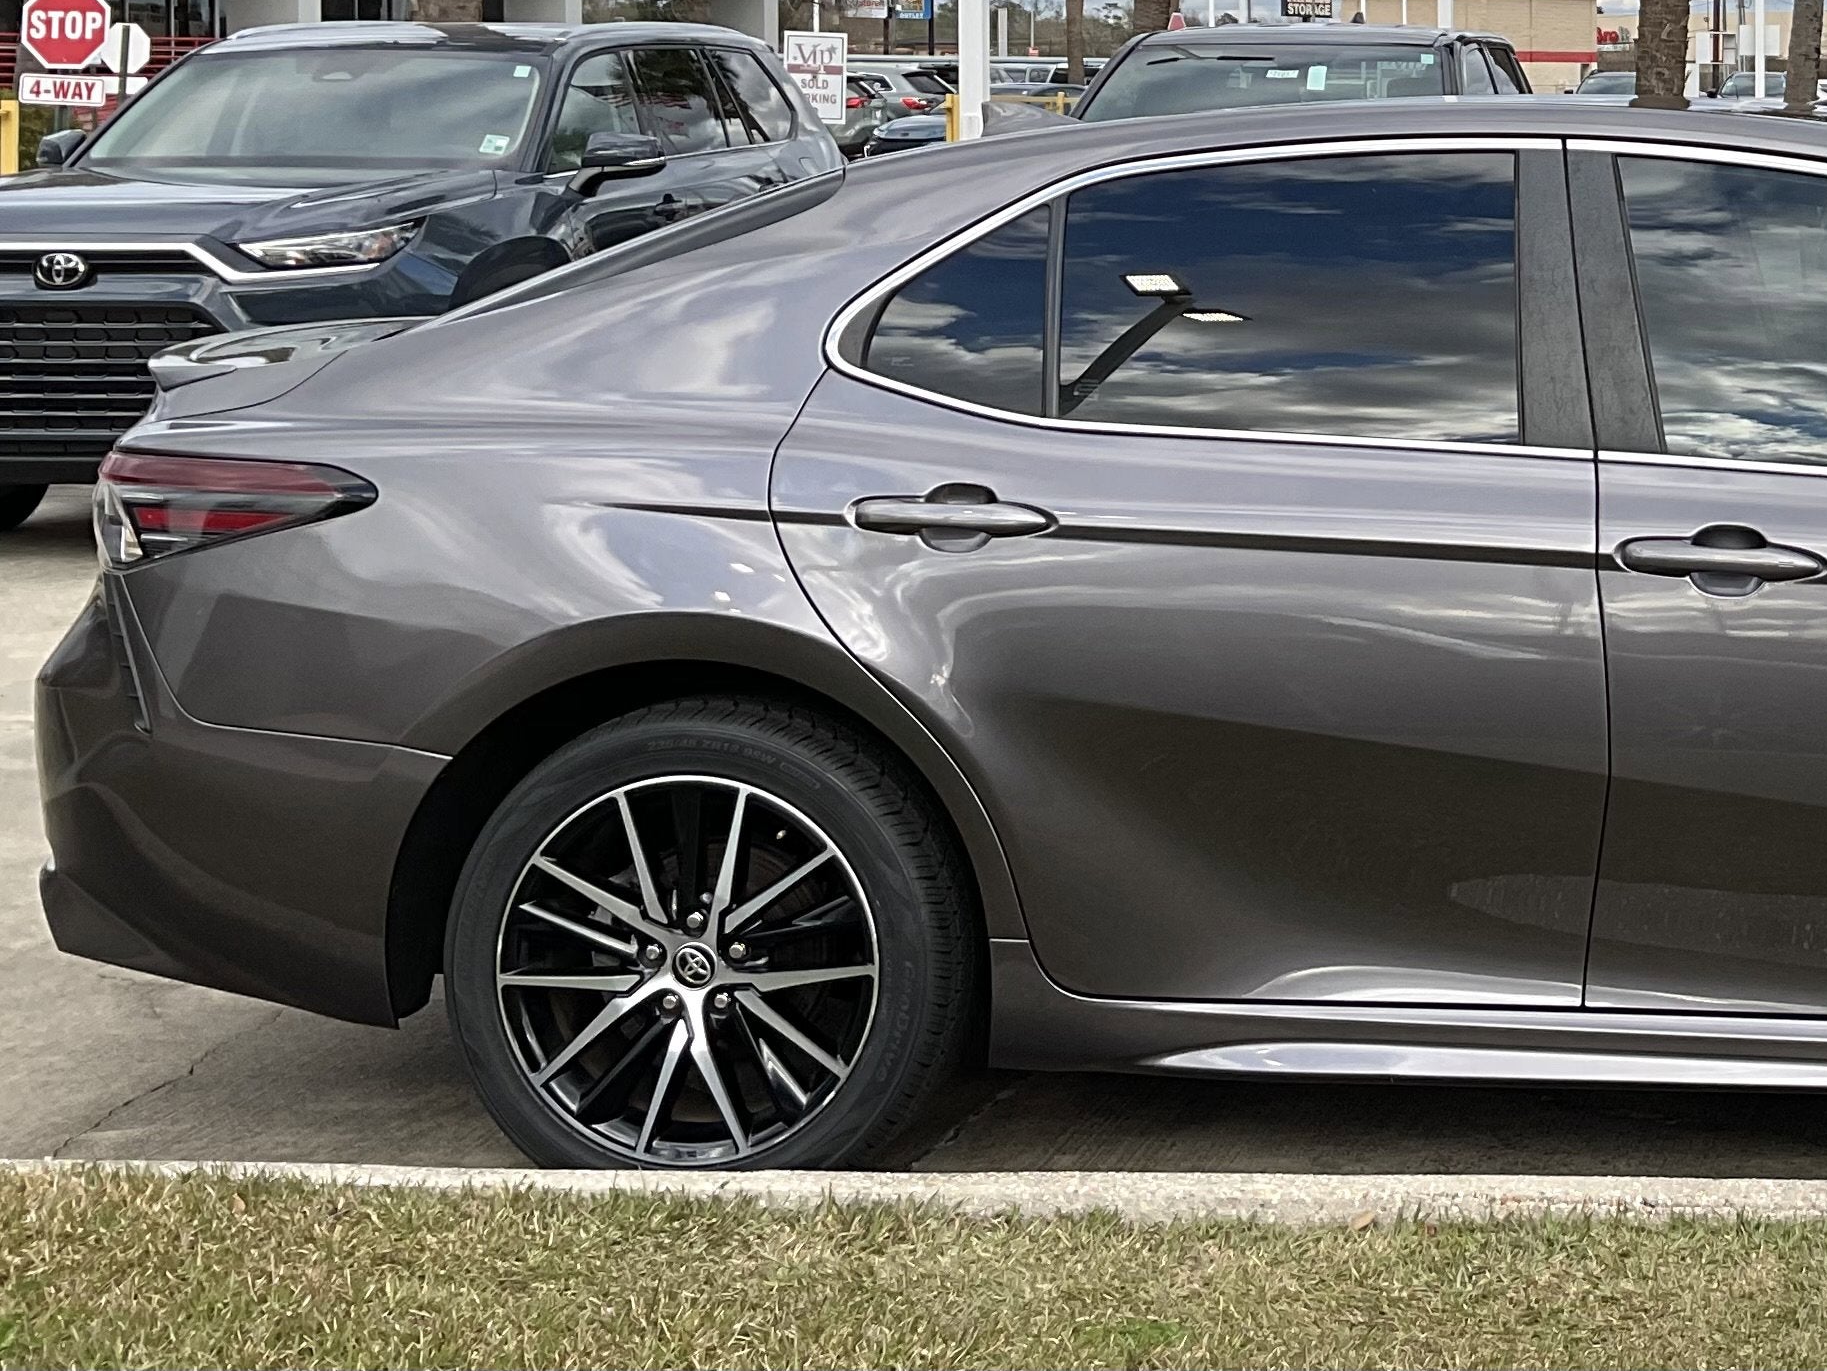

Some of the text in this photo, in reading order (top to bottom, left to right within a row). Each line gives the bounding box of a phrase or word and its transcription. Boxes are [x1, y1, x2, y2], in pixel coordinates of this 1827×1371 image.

[29, 10, 103, 40] STOP
[29, 80, 96, 101] 4-WAY
[800, 78, 829, 90] SOLD
[804, 93, 837, 105] RKING
